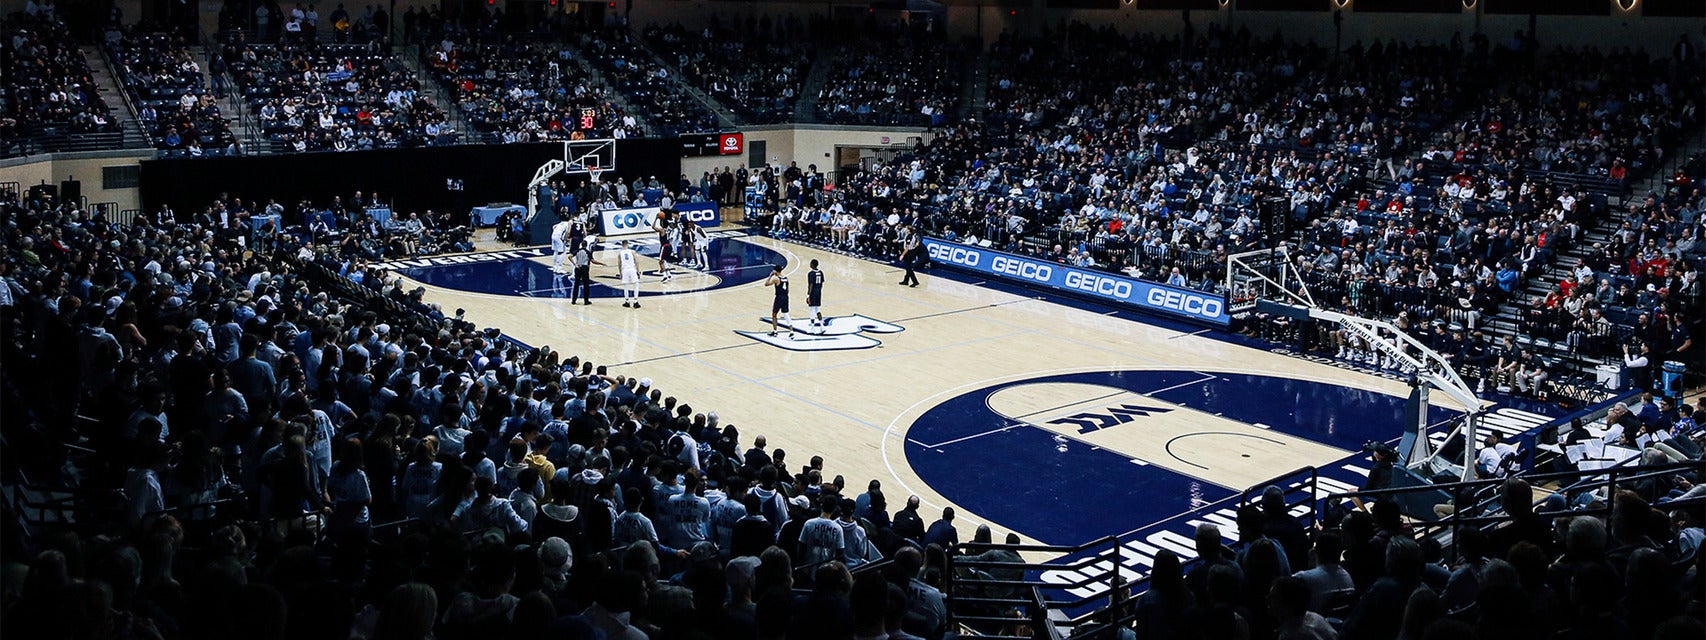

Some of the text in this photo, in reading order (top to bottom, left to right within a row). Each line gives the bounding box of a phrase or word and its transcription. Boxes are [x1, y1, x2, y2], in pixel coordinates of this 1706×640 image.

[581, 117, 593, 129] 30
[613, 211, 651, 229] COX
[679, 208, 716, 222] ICO
[367, 248, 545, 270] NIVERSITY
[926, 242, 1223, 318] GEICO GEICO GEICO GEICO
[1339, 317, 1375, 343] UNIVERSITY
[1384, 346, 1399, 358] SAN
[674, 500, 699, 510] HOME
[814, 523, 838, 537] HOME
